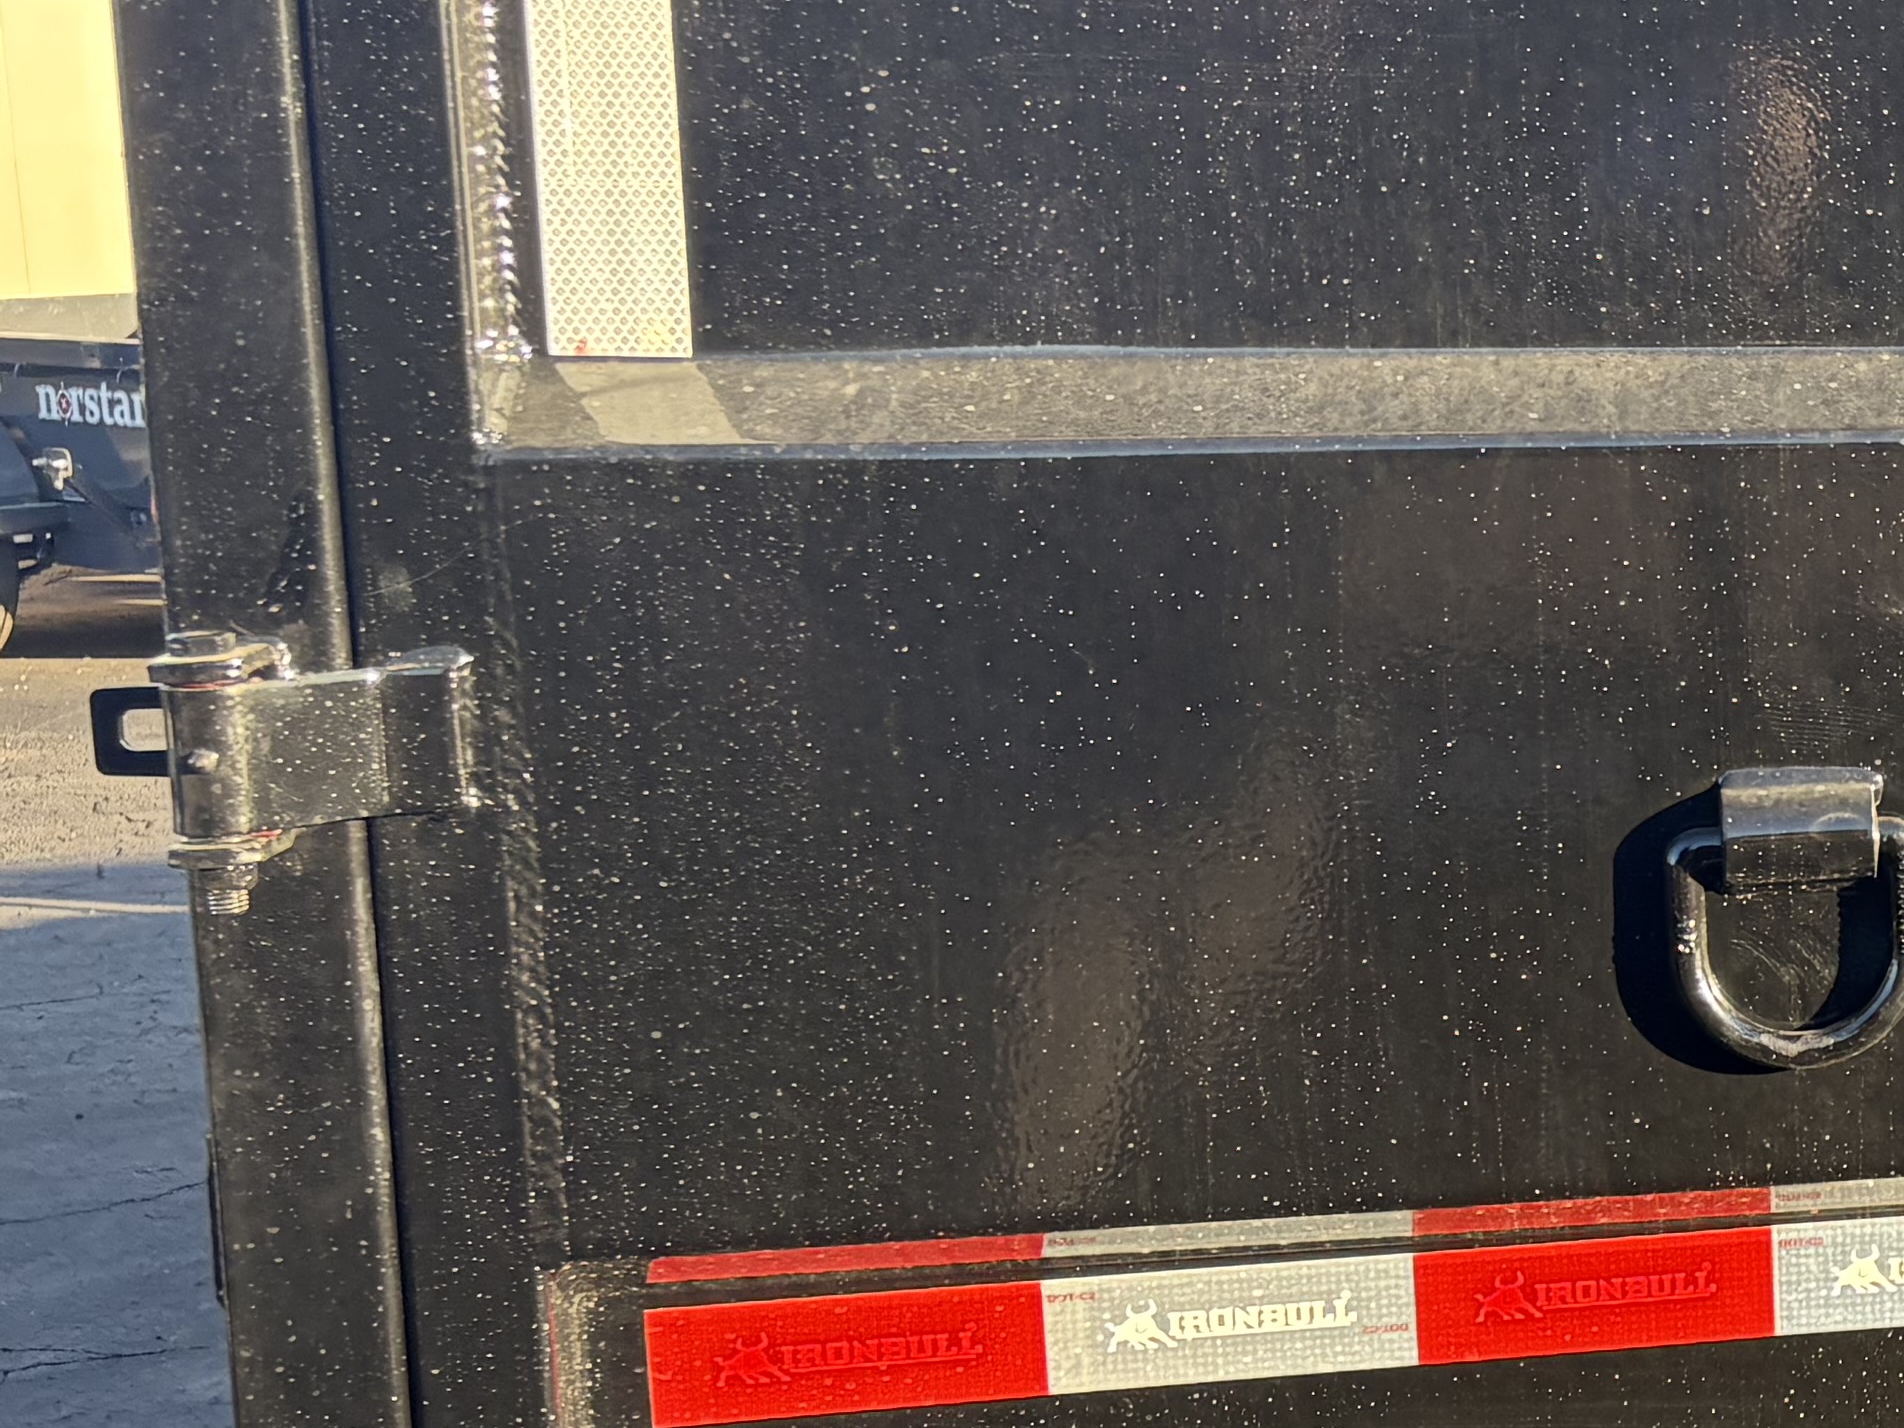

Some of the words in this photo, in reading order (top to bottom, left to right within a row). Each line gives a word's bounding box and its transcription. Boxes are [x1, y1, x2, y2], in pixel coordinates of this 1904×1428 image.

[1534, 1262, 1717, 1310] IRONBULL
[1167, 1290, 1358, 1339] IRONBULL
[781, 1322, 984, 1369] IRONBULL
